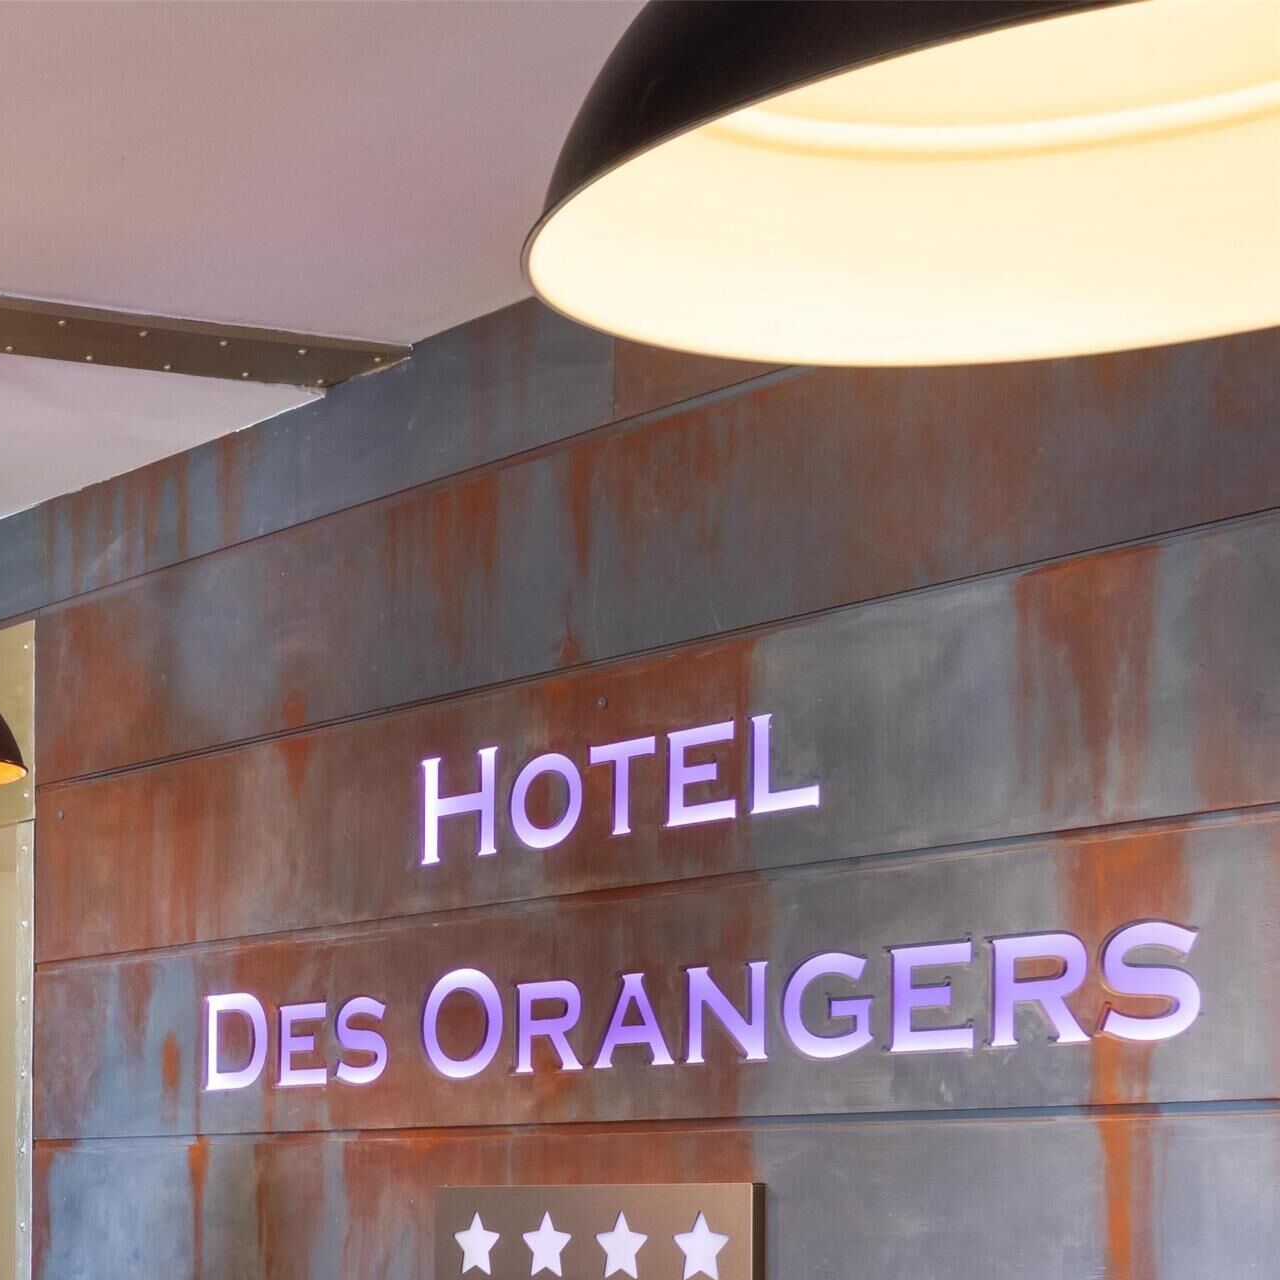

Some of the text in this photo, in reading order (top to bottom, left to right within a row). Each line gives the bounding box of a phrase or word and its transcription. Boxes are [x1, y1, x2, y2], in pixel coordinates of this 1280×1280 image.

[420, 712, 821, 866] HOTEL
[202, 919, 1202, 1091] DES ORANGERS
